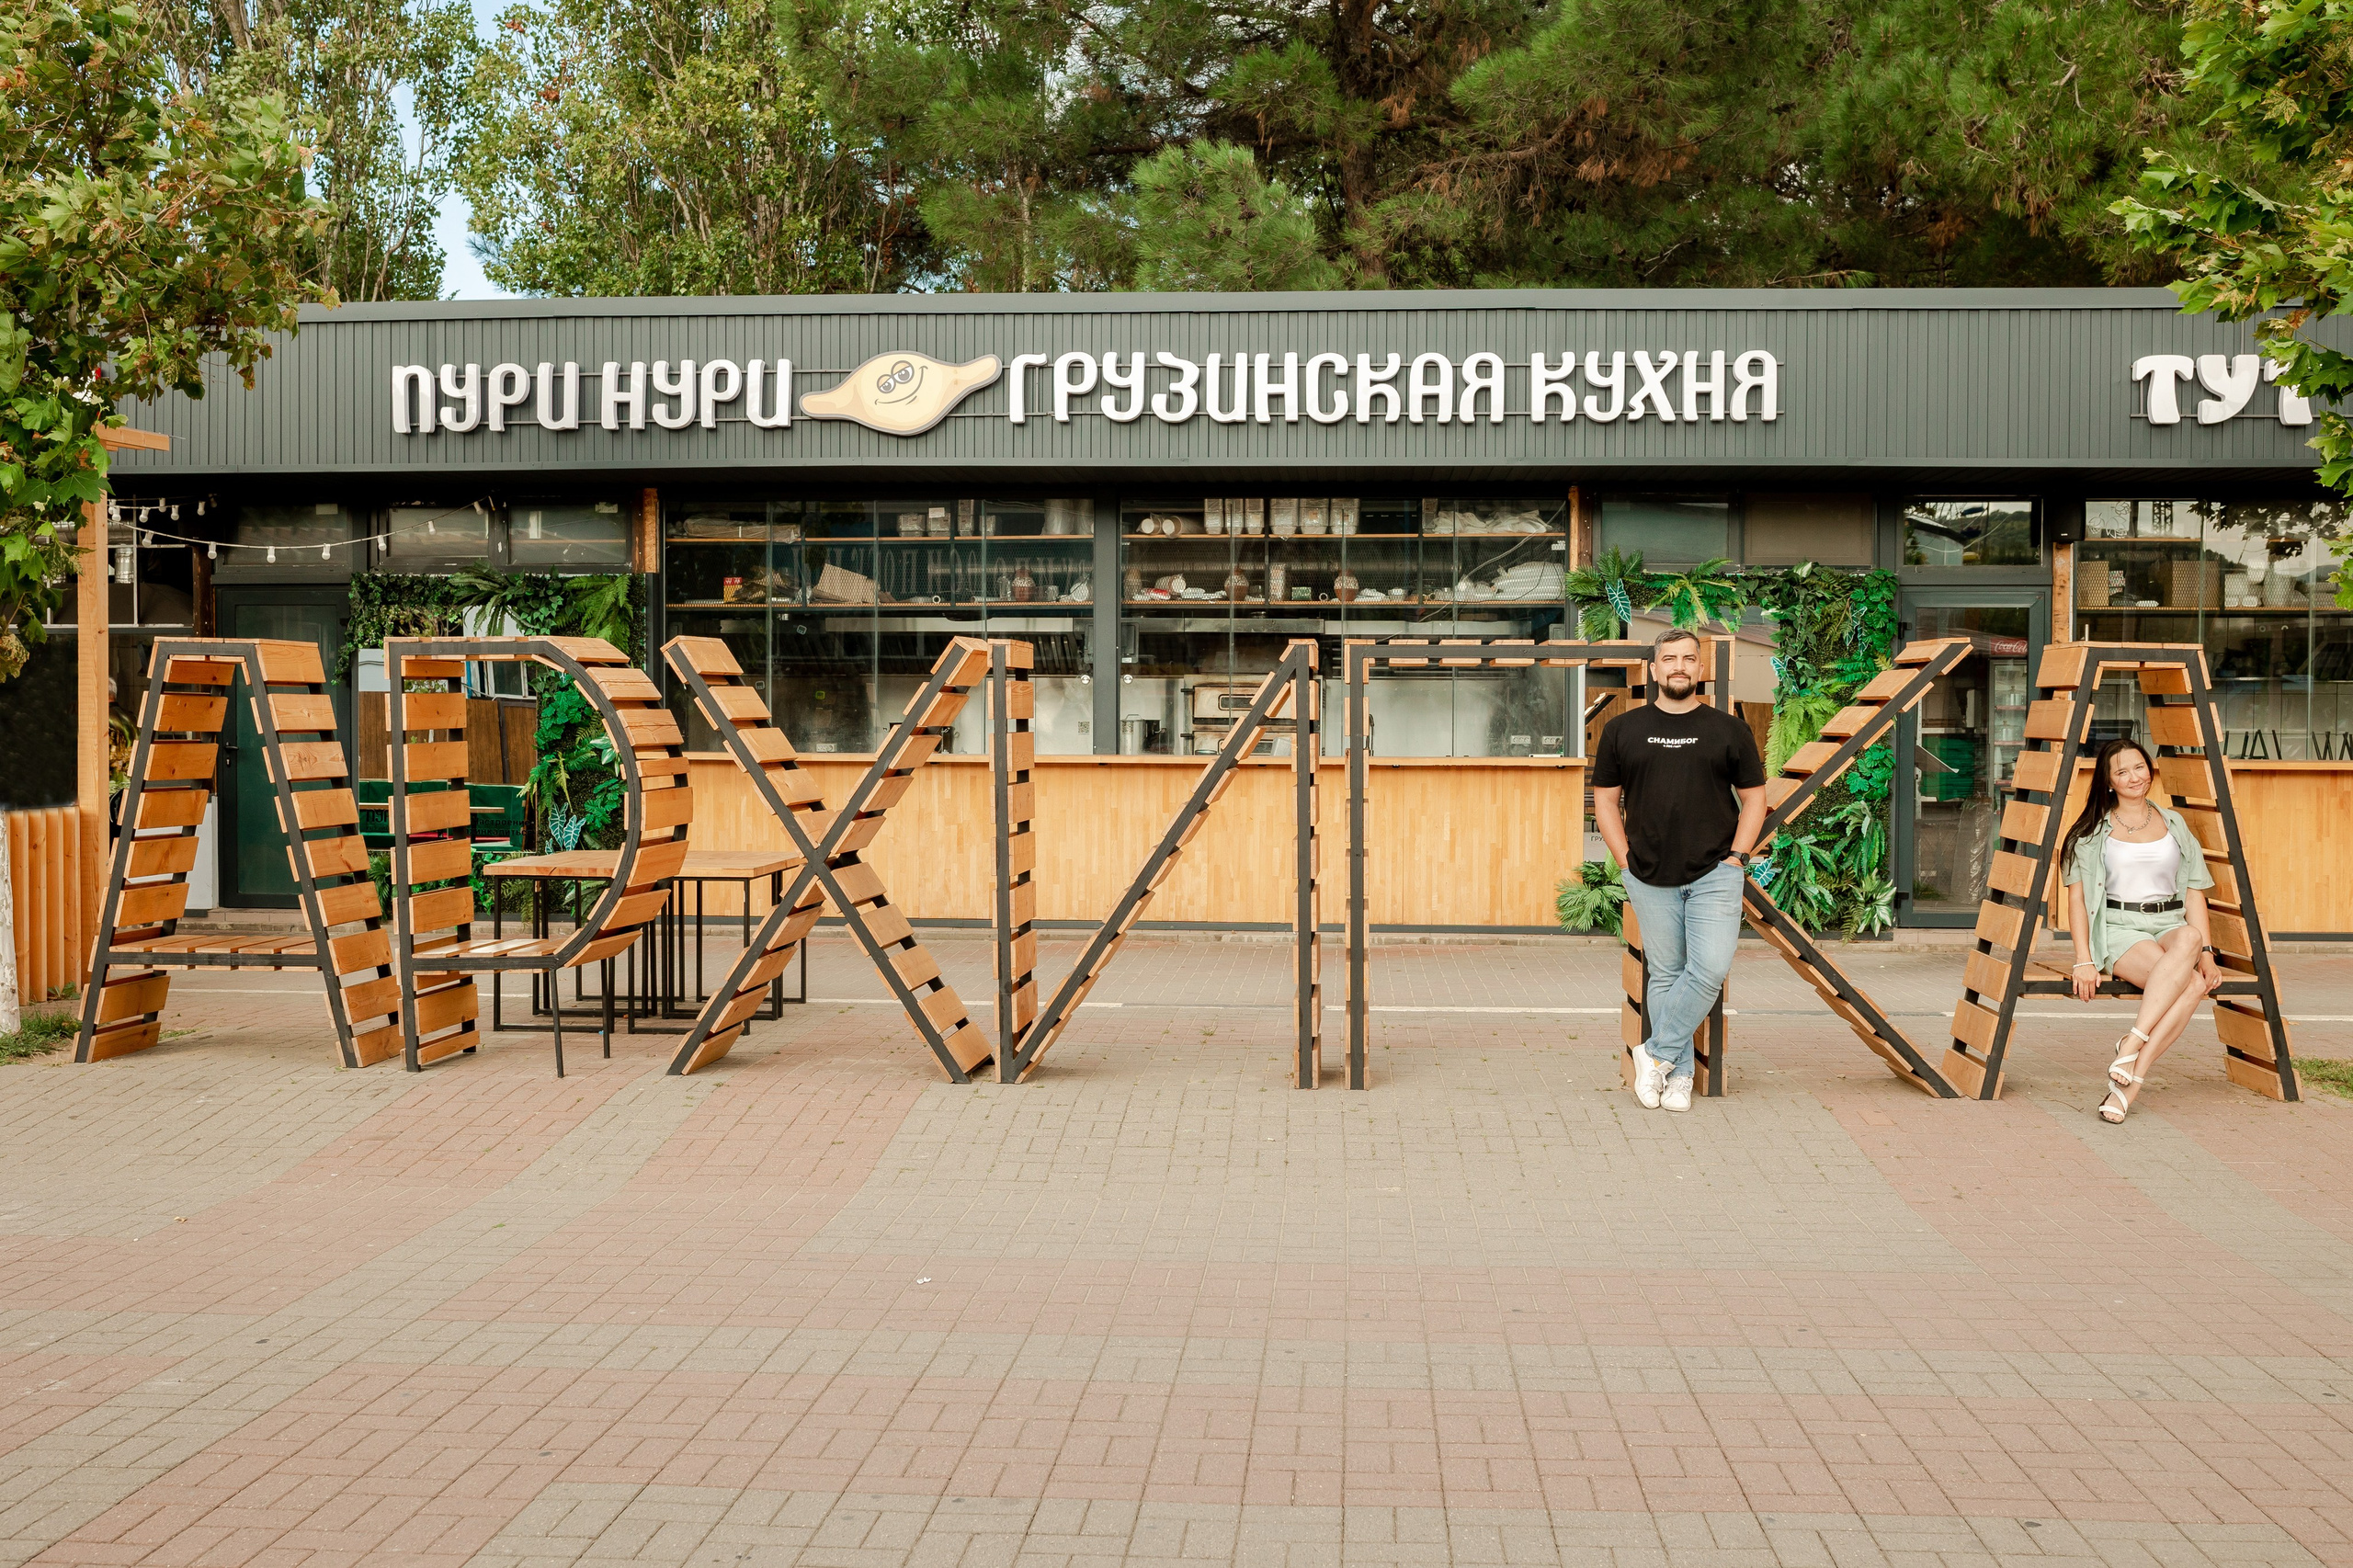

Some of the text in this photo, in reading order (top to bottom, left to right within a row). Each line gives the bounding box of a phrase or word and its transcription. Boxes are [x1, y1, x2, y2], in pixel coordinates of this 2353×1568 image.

[392, 358, 792, 434] ПУРИ НУРИ
[1009, 349, 1779, 425] ГРУЗИНСКАЯ КУХНЯ
[1995, 640, 2028, 653] Coca-Col
[1647, 736, 1699, 745] СНАМИБОГ
